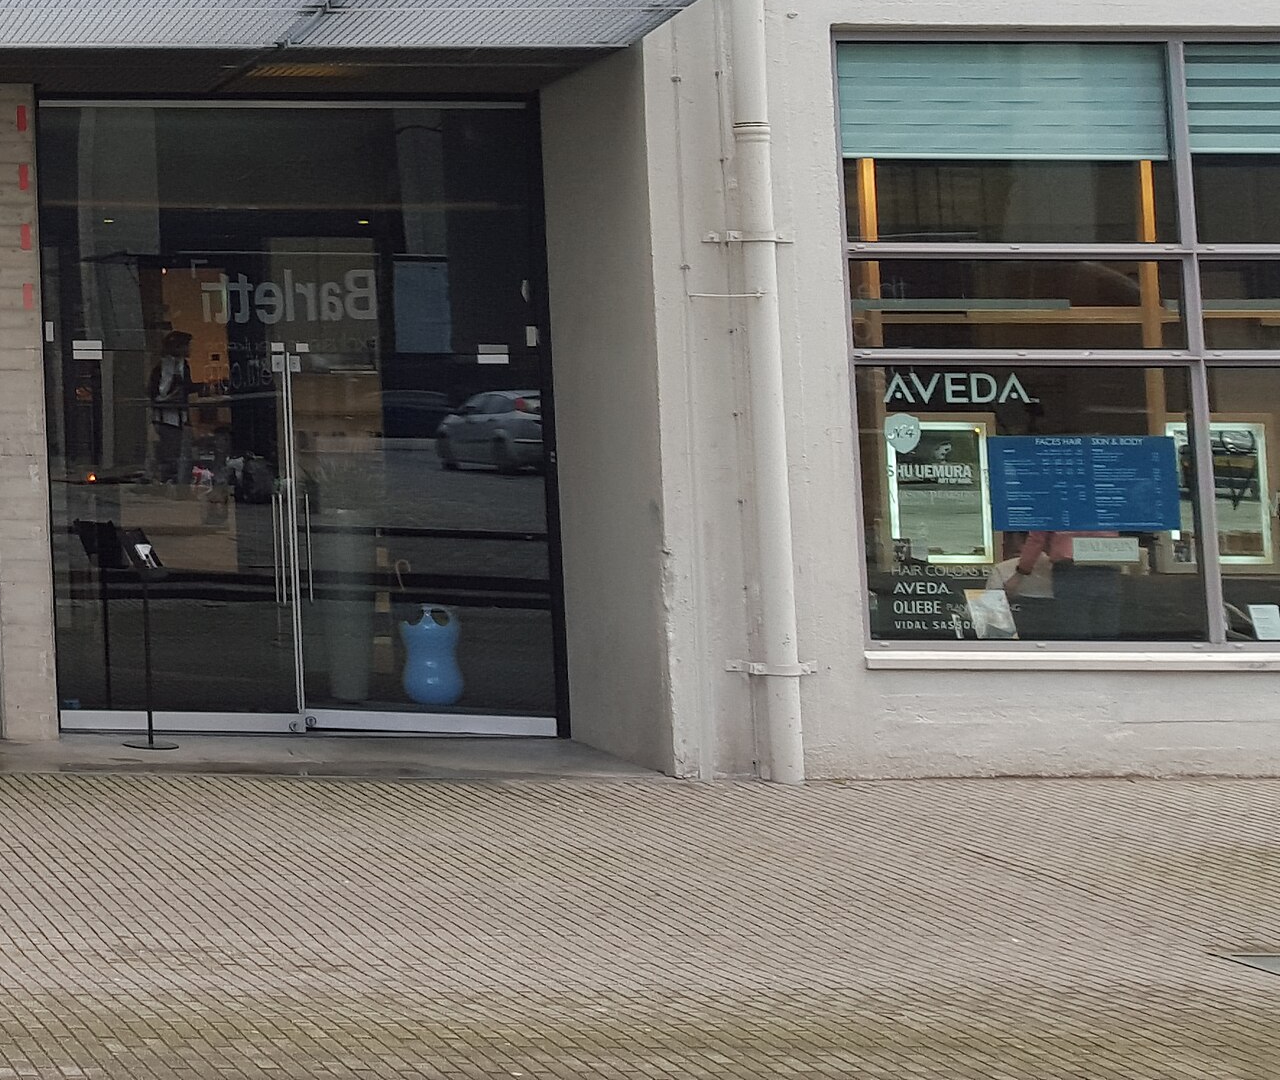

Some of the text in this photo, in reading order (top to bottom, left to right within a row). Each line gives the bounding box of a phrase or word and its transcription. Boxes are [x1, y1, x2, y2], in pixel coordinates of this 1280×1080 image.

[883, 372, 1040, 404] AVEDA
[1062, 437, 1082, 446] HAIR
[1120, 437, 1144, 446] BODY
[915, 464, 973, 479] UEMURA
[892, 565, 923, 577] HAIR
[925, 565, 980, 578] COLORS
[893, 582, 952, 595] AVEDA
[894, 620, 928, 630] VIDAL
